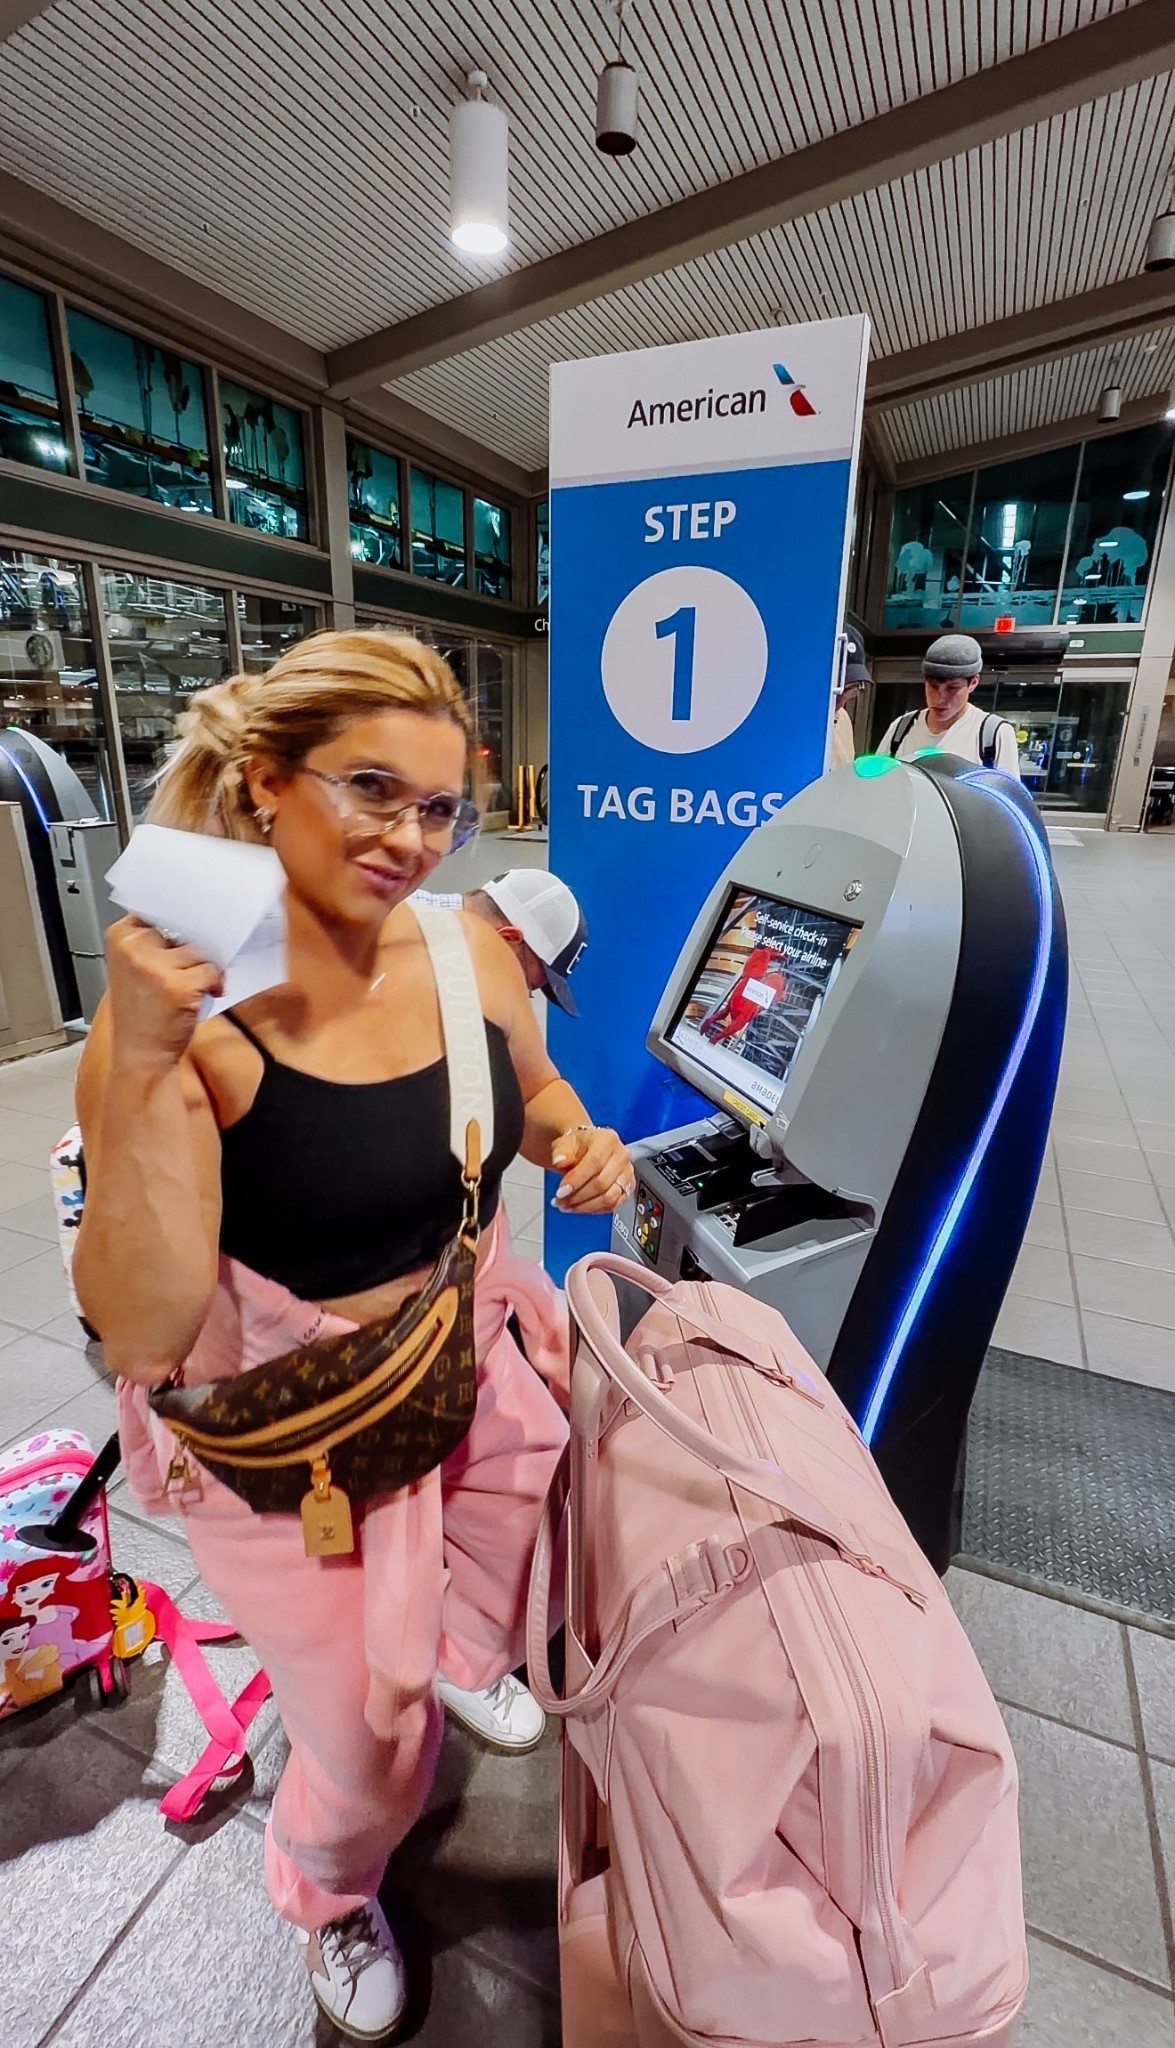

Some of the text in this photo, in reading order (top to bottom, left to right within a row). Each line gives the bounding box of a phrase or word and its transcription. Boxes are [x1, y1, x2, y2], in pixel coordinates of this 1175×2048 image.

[627, 388, 766, 429] American
[644, 500, 737, 543] STEP
[655, 606, 696, 721] 1
[577, 784, 783, 827] TAG BAGS
[740, 926, 828, 969] Please select your airline
[753, 911, 828, 948] Self-service check-in
